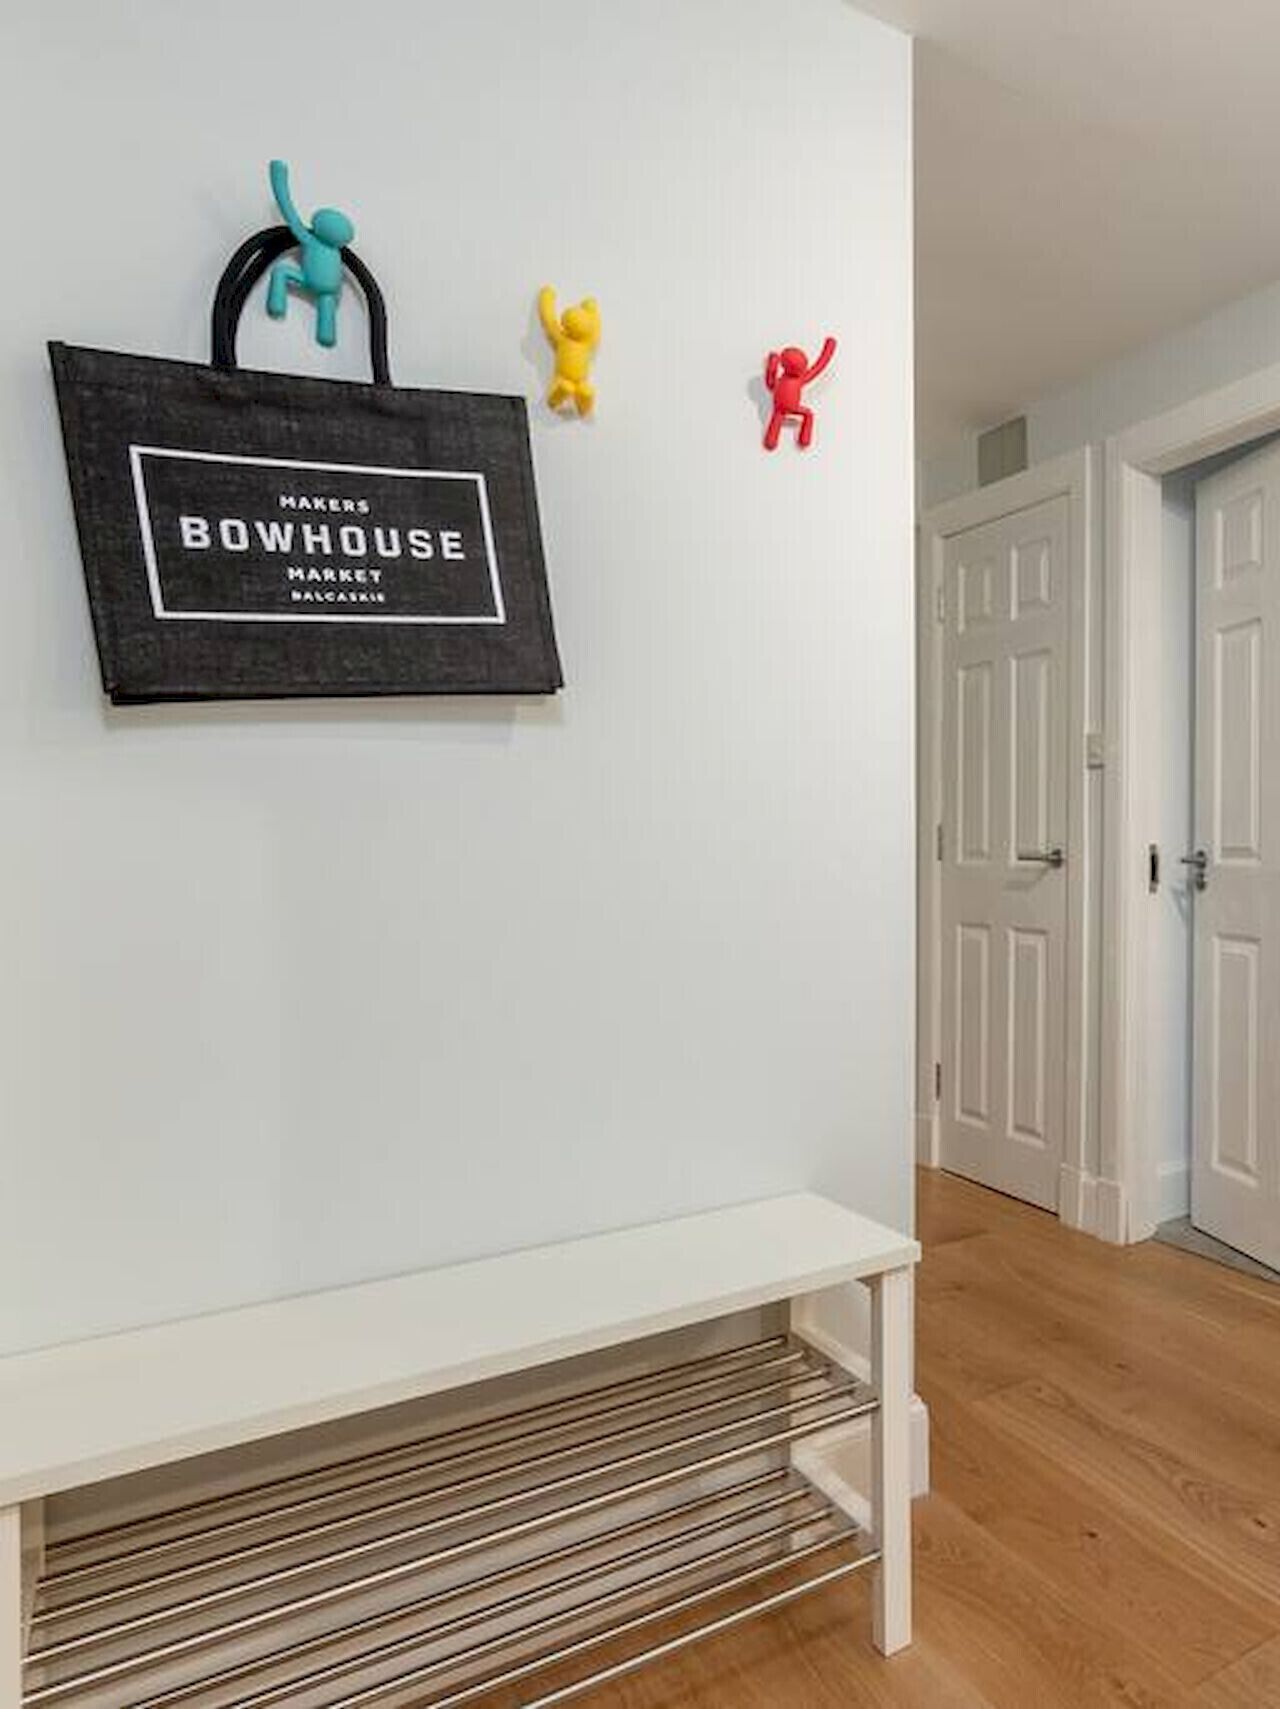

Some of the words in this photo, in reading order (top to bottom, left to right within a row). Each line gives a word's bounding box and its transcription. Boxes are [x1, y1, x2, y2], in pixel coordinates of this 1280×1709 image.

[280, 496, 370, 514] MAKERS
[180, 516, 467, 561] BOWHOUSE
[287, 567, 382, 583] MARKET
